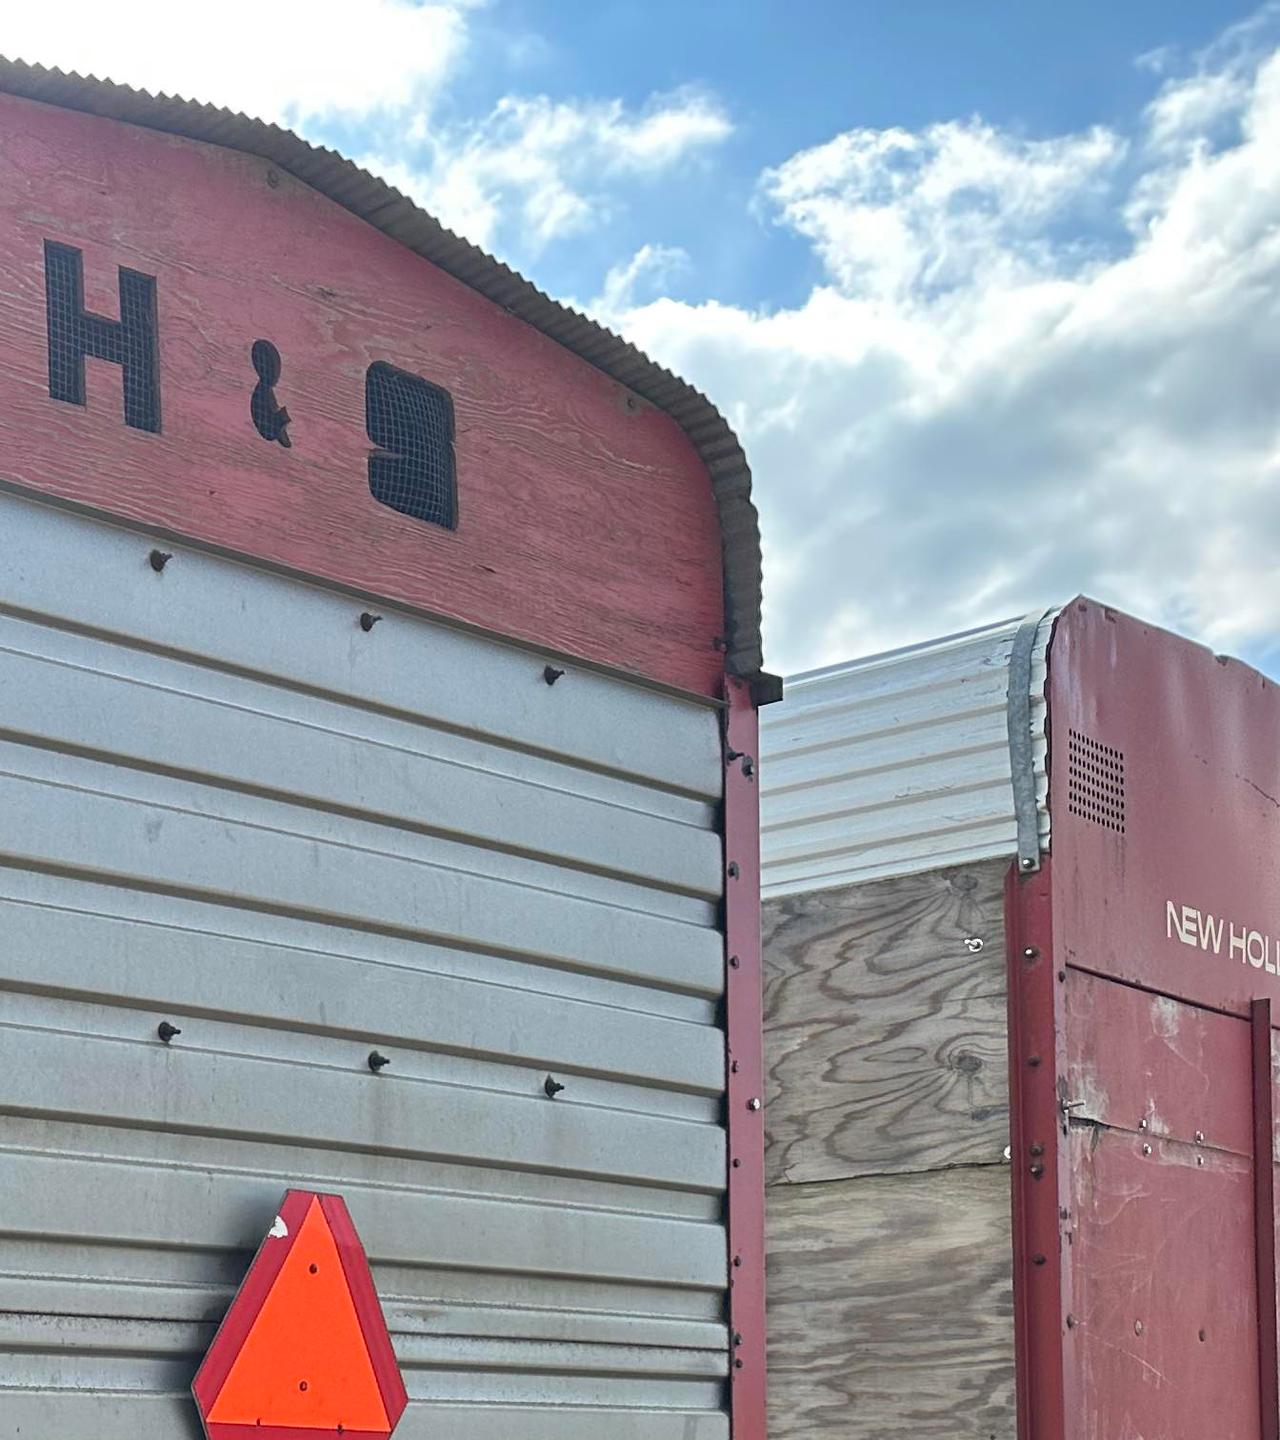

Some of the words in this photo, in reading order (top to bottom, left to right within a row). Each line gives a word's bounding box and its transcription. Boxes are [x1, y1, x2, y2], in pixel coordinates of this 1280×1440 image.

[43, 238, 162, 434] H
[250, 338, 292, 449] &
[1166, 900, 1224, 955] NEW
